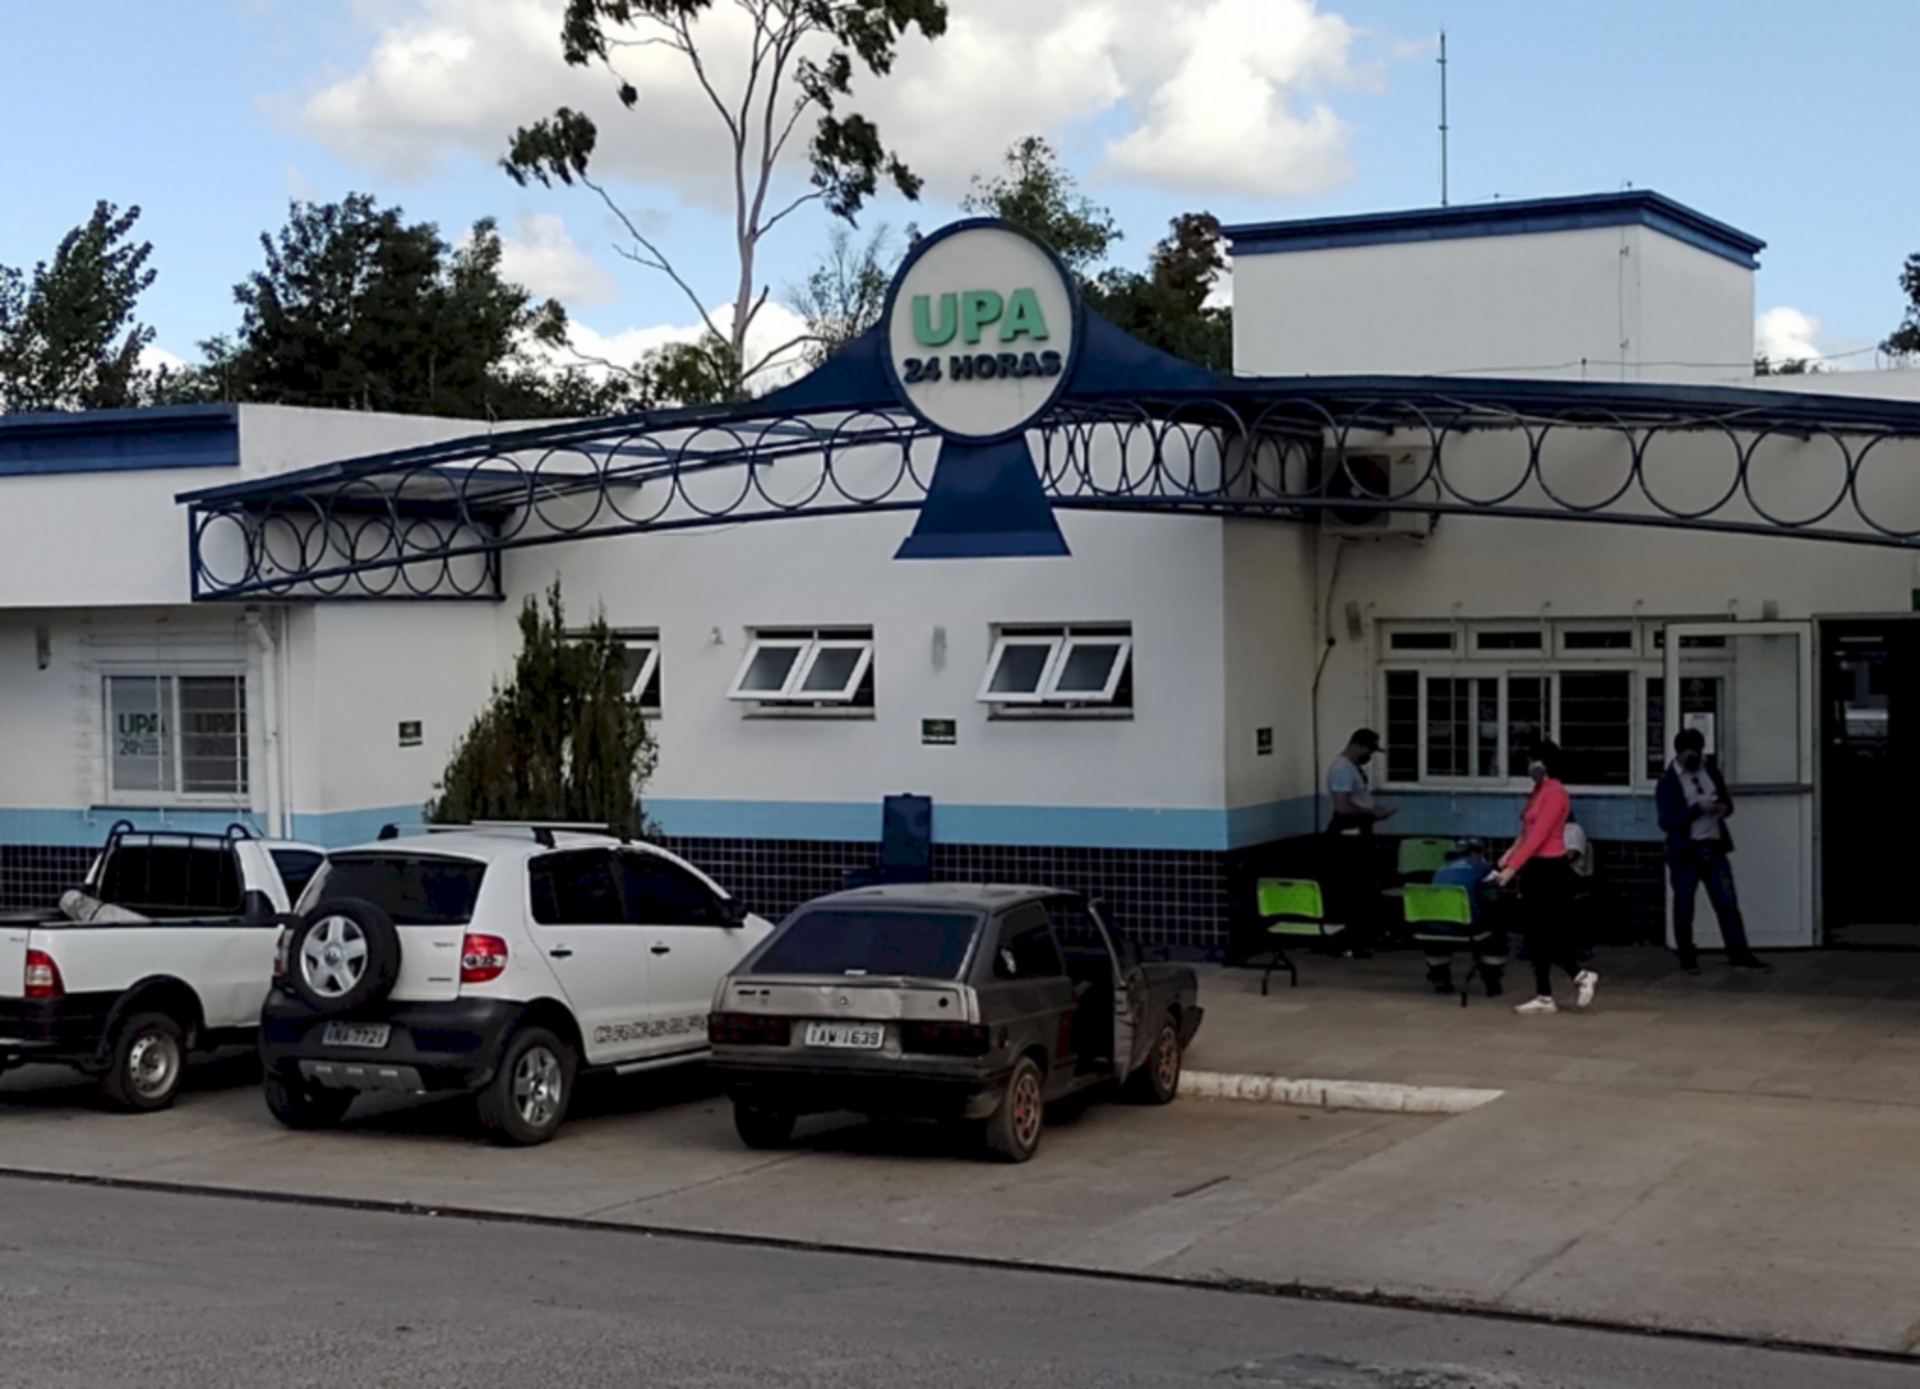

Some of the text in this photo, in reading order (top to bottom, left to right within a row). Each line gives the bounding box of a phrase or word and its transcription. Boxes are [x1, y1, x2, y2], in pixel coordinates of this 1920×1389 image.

[911, 287, 1050, 347] UPA
[903, 350, 1063, 384] 24 HORAS
[118, 712, 168, 737] UPA
